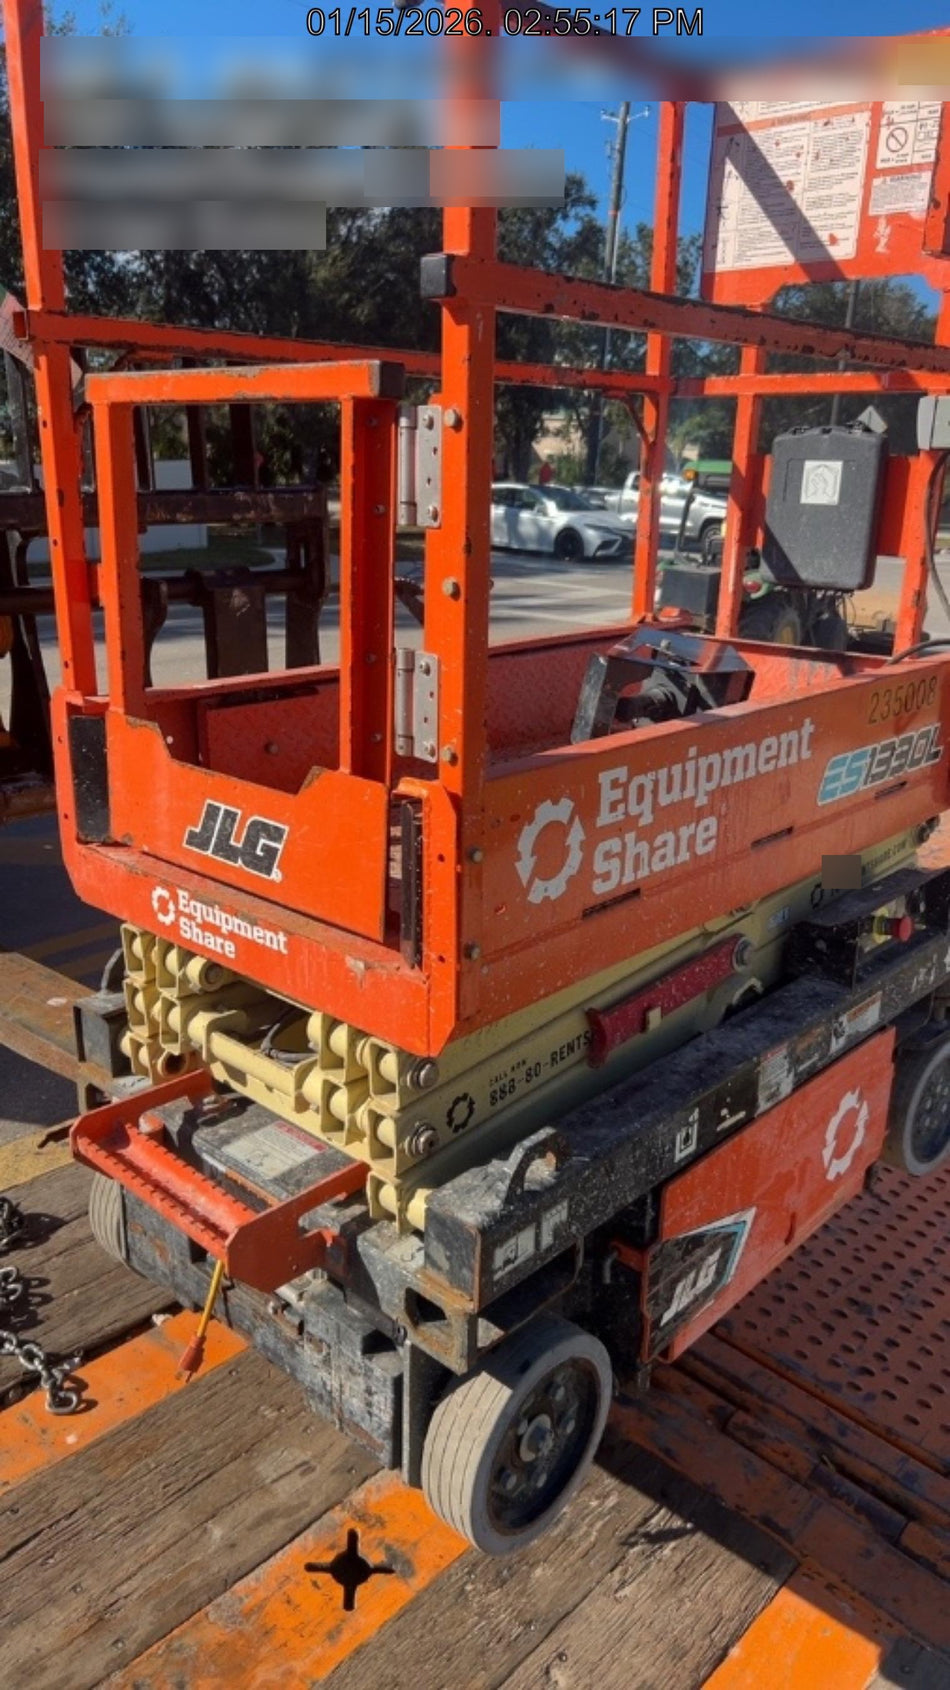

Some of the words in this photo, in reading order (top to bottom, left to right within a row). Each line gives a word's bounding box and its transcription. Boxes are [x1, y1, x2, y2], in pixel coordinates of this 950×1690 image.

[868, 676, 938, 725] 235008
[596, 717, 815, 827] Equipment
[817, 723, 944, 806] ES1330L
[182, 798, 290, 881] JLG
[592, 815, 718, 895] Share
[176, 887, 288, 954] Equipment
[179, 915, 236, 959] Share
[660, 1247, 722, 1327] JLG
